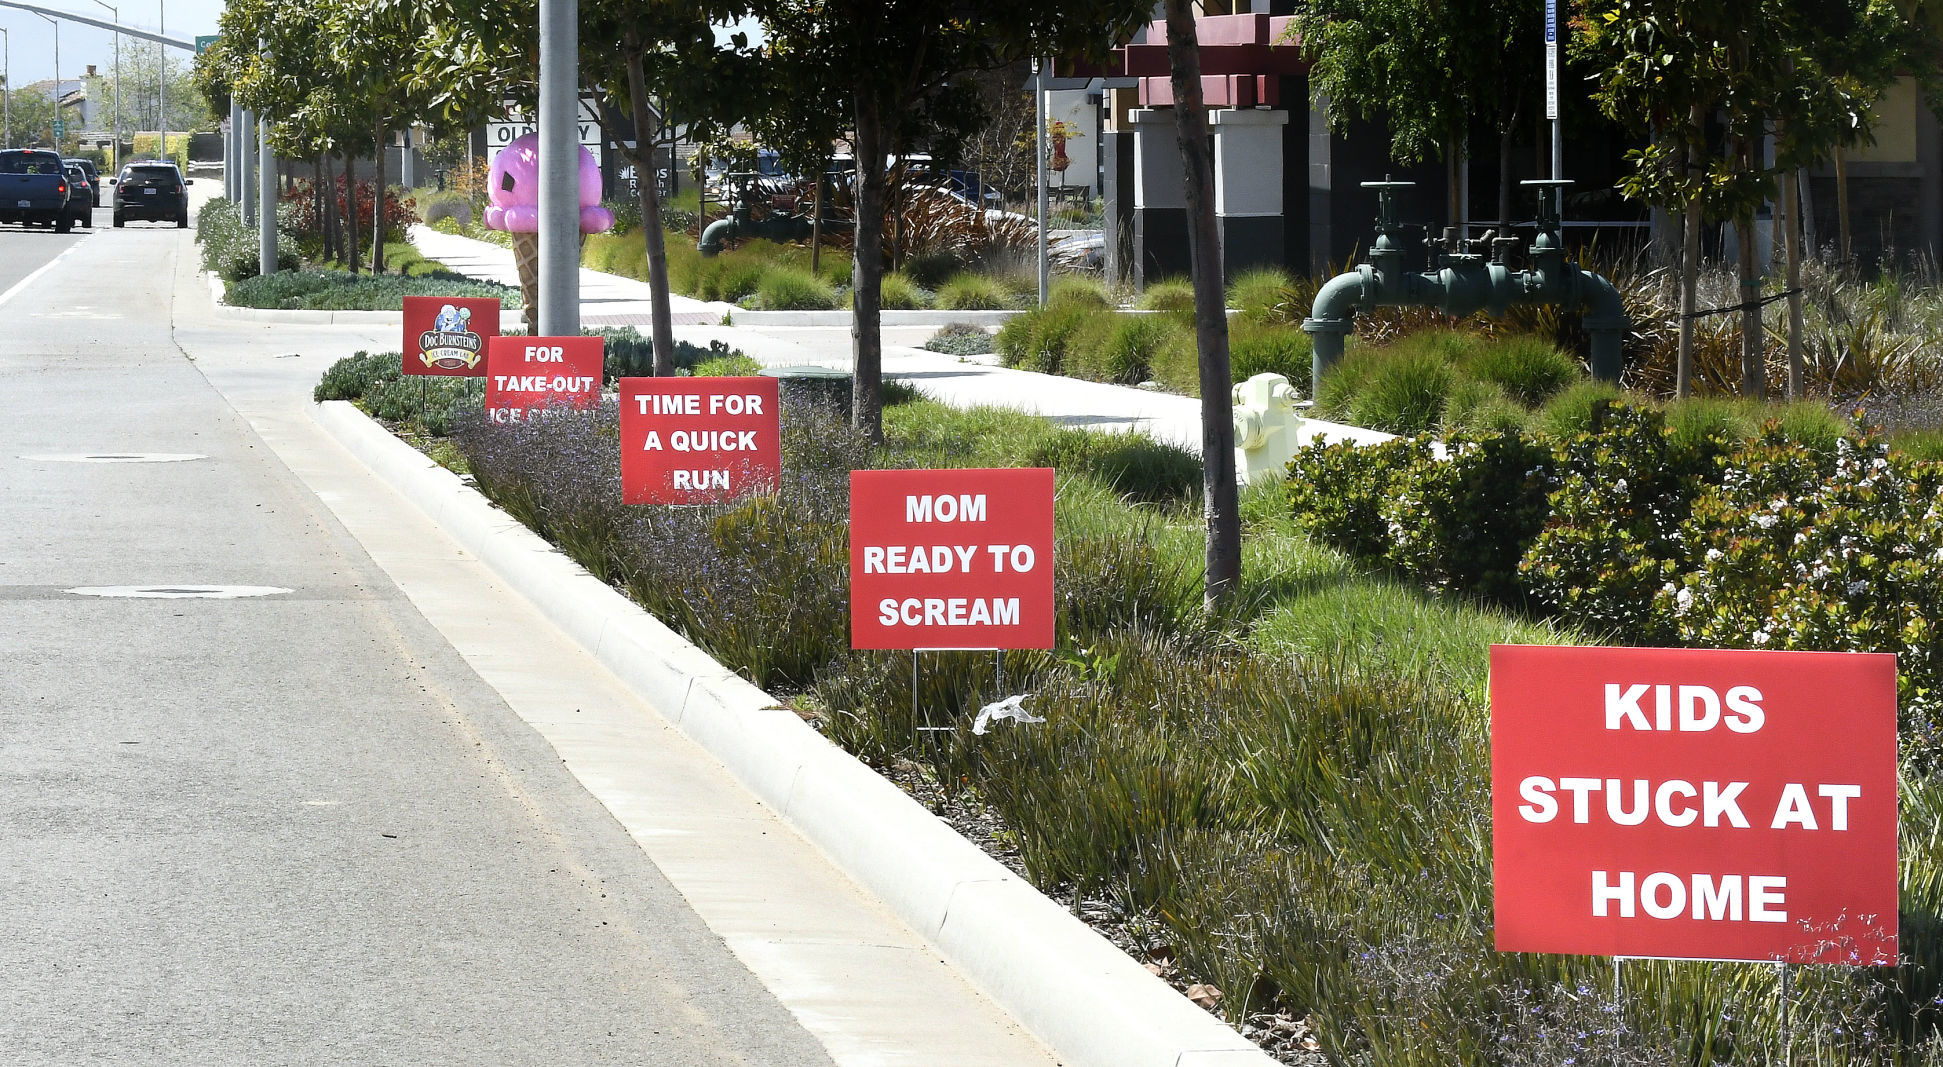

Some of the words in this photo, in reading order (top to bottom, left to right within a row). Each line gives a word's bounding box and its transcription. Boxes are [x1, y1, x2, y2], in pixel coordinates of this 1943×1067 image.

[524, 346, 564, 363] FOR
[494, 375, 594, 393] TAKE-OUT
[489, 407, 522, 424] ICE
[634, 394, 701, 415] TIME
[709, 394, 764, 415] FOR
[643, 430, 663, 451] A
[670, 430, 758, 453] QUICK
[673, 469, 730, 491] RUN
[905, 494, 987, 523] MOM
[863, 545, 978, 574] READY
[988, 544, 1035, 573] TO
[878, 597, 1020, 626] SCREAM
[1604, 683, 1766, 734] KIDS
[1518, 775, 1751, 829] STUCK
[1770, 783, 1861, 832] AT
[1591, 870, 1788, 923] HOME
